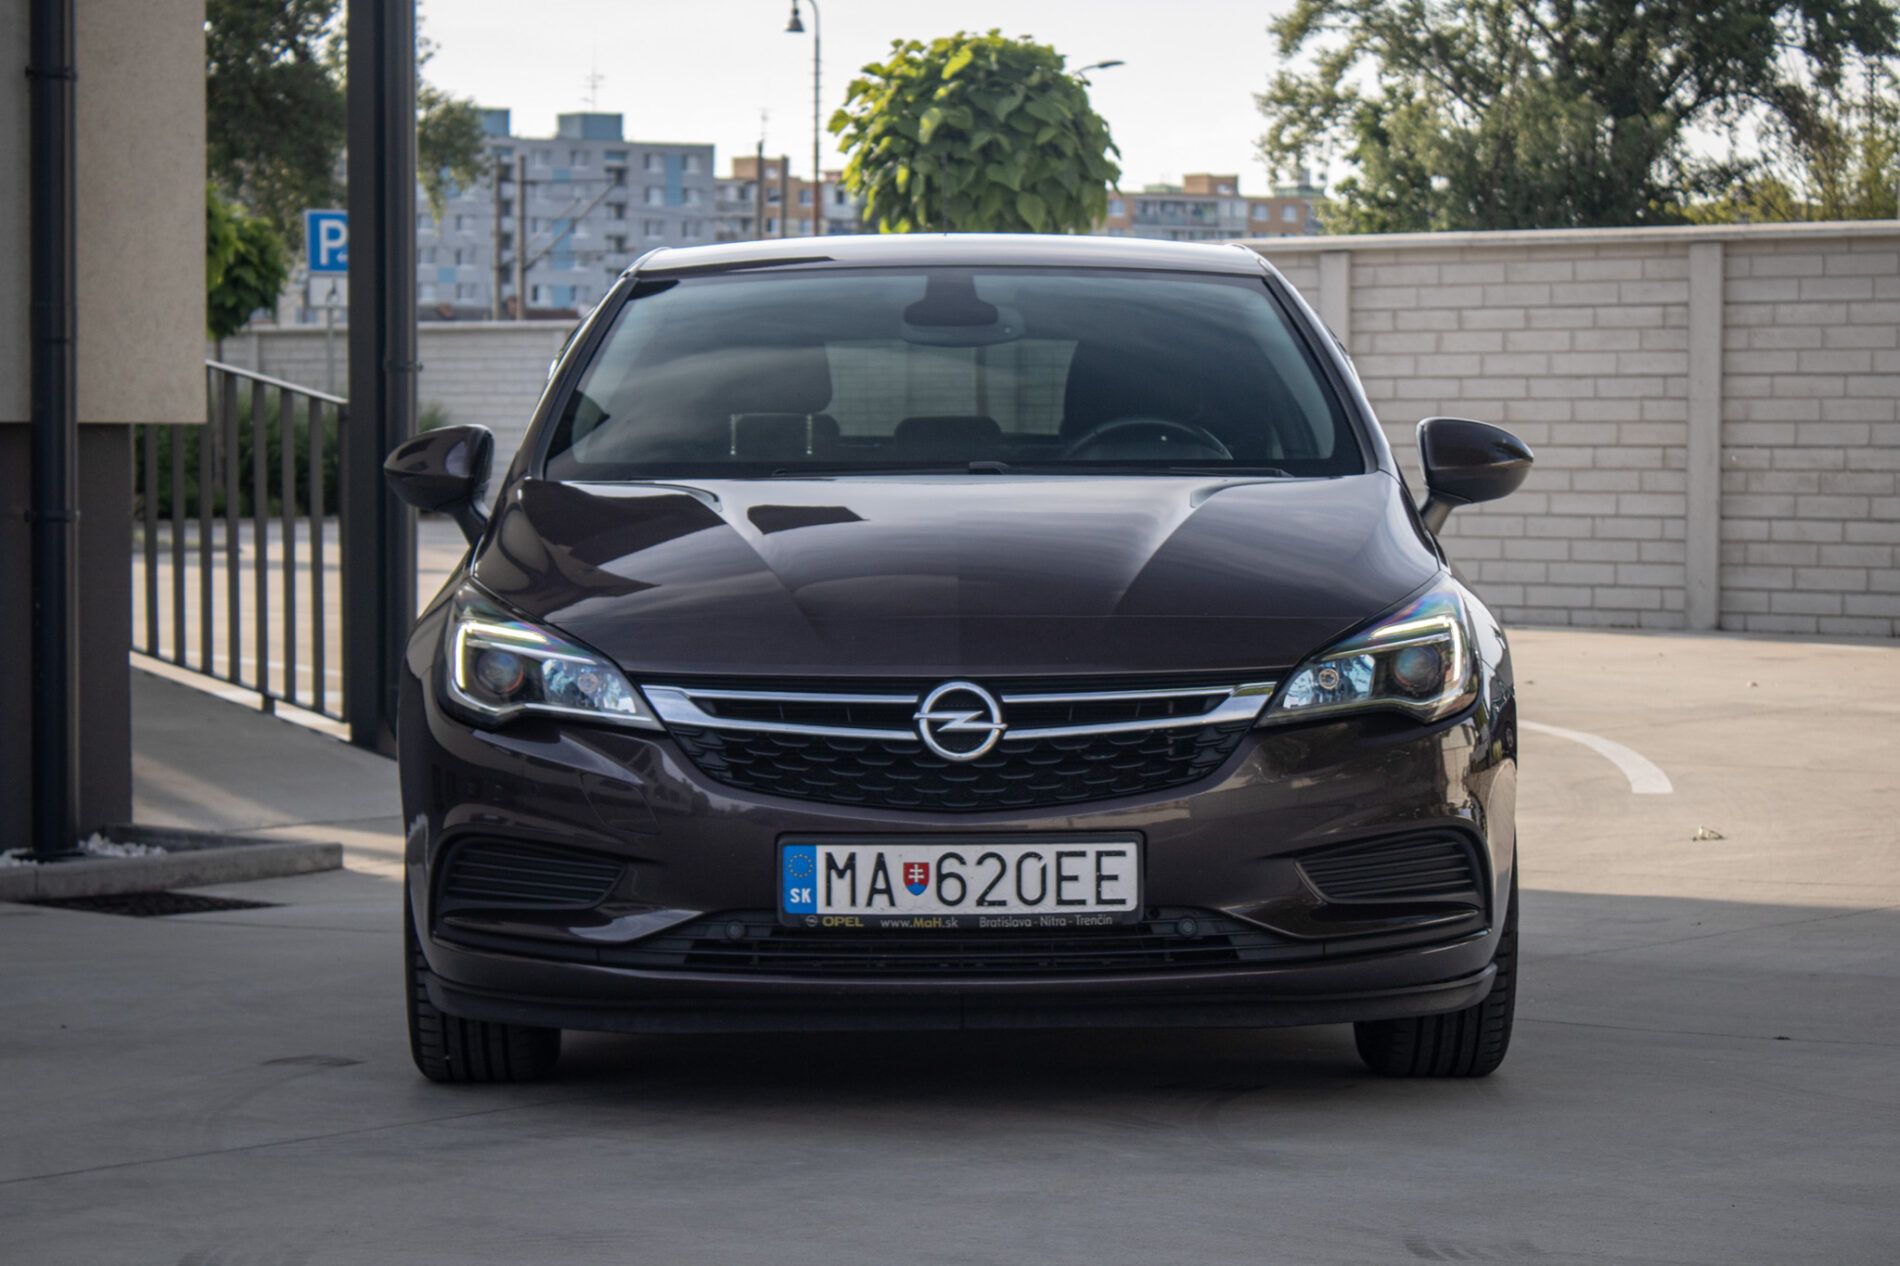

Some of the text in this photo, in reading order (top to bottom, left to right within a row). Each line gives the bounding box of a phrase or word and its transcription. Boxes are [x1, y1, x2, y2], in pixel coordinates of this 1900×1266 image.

[320, 219, 348, 266] P
[824, 850, 1127, 907] MA 620EE
[790, 888, 811, 904] SK
[822, 916, 864, 928] OPEL
[880, 917, 959, 929] www.MaH.sk
[979, 916, 1032, 928] Bratislava
[1040, 916, 1067, 928] Nitra
[1075, 914, 1113, 927] Trenčín
